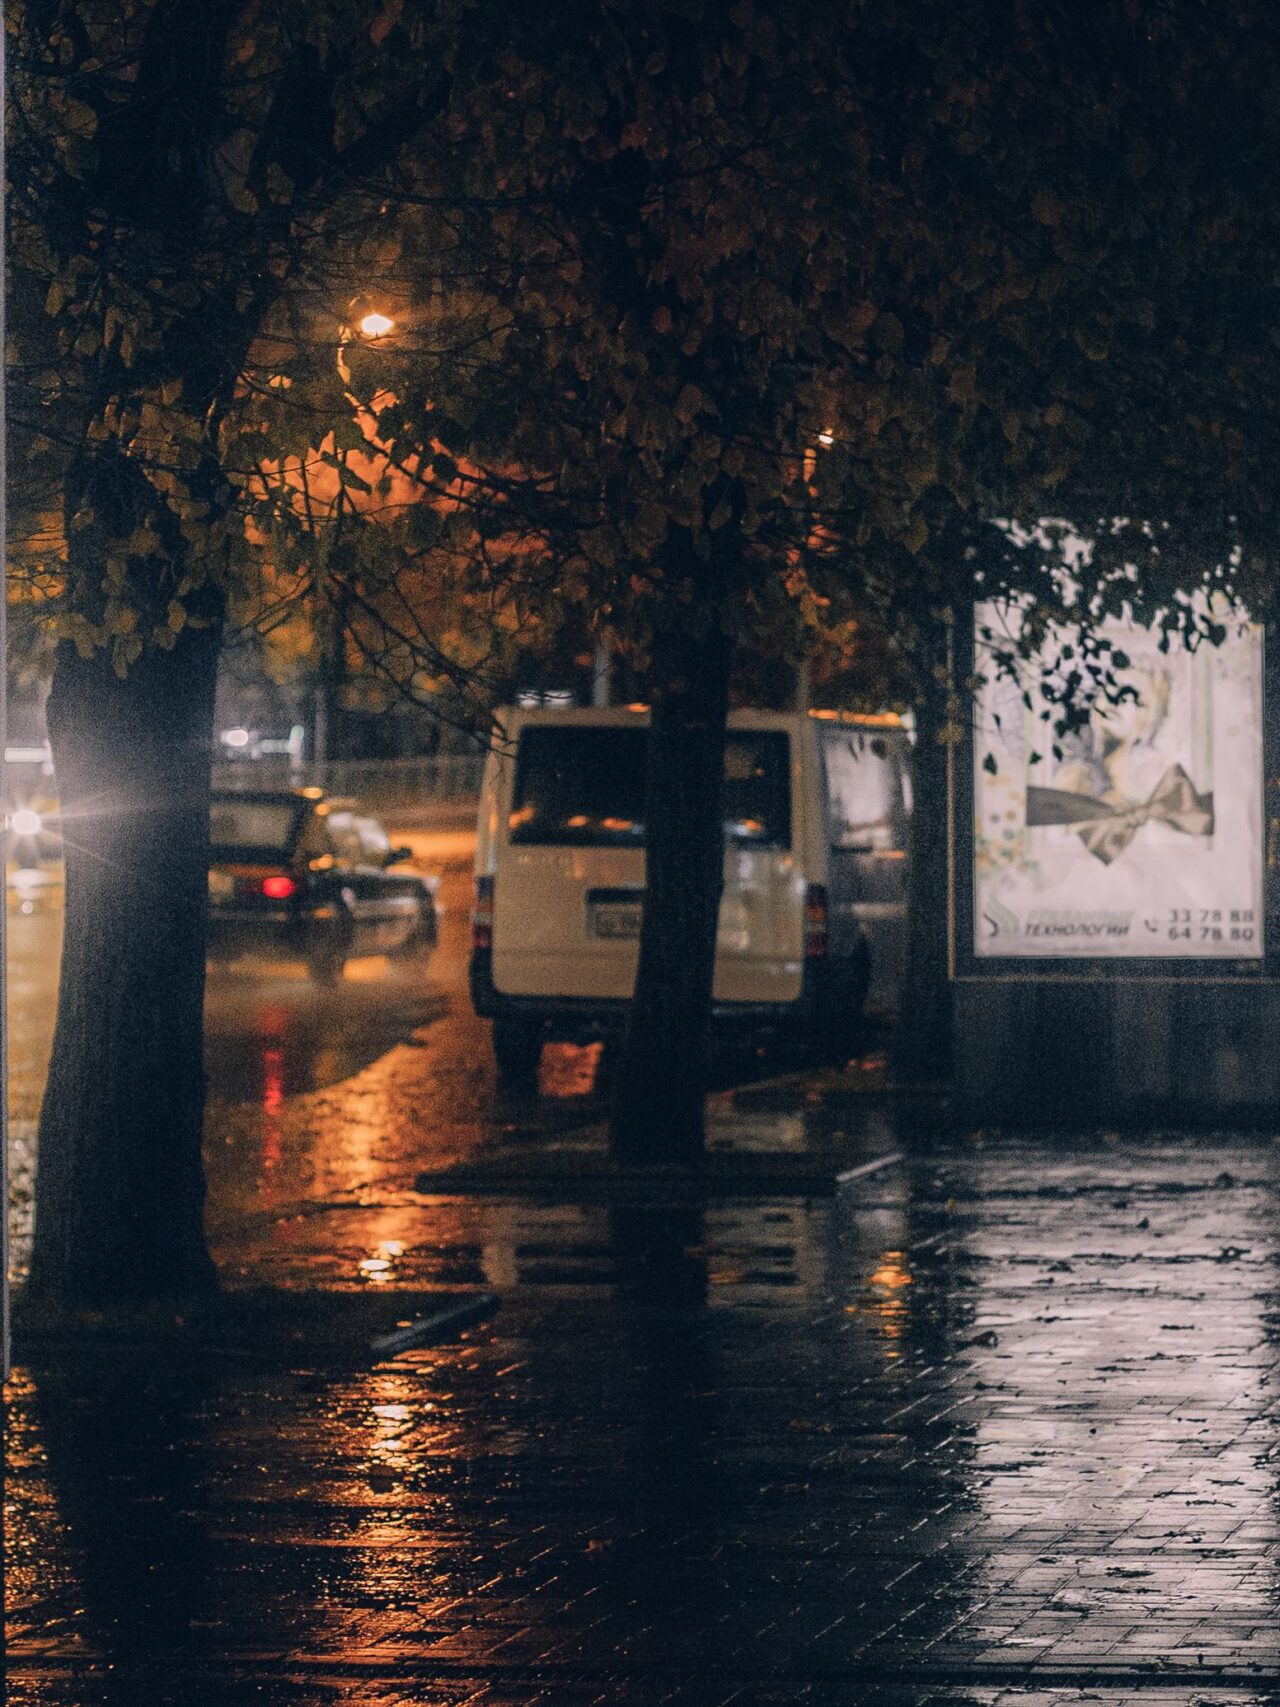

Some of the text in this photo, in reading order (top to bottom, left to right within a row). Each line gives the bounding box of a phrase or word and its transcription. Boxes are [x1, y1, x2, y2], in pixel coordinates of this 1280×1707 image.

[1025, 923, 1130, 937] ТЕХНОЛОГИИ
[1168, 927, 1191, 940] 64
[1201, 927, 1222, 940] 78
